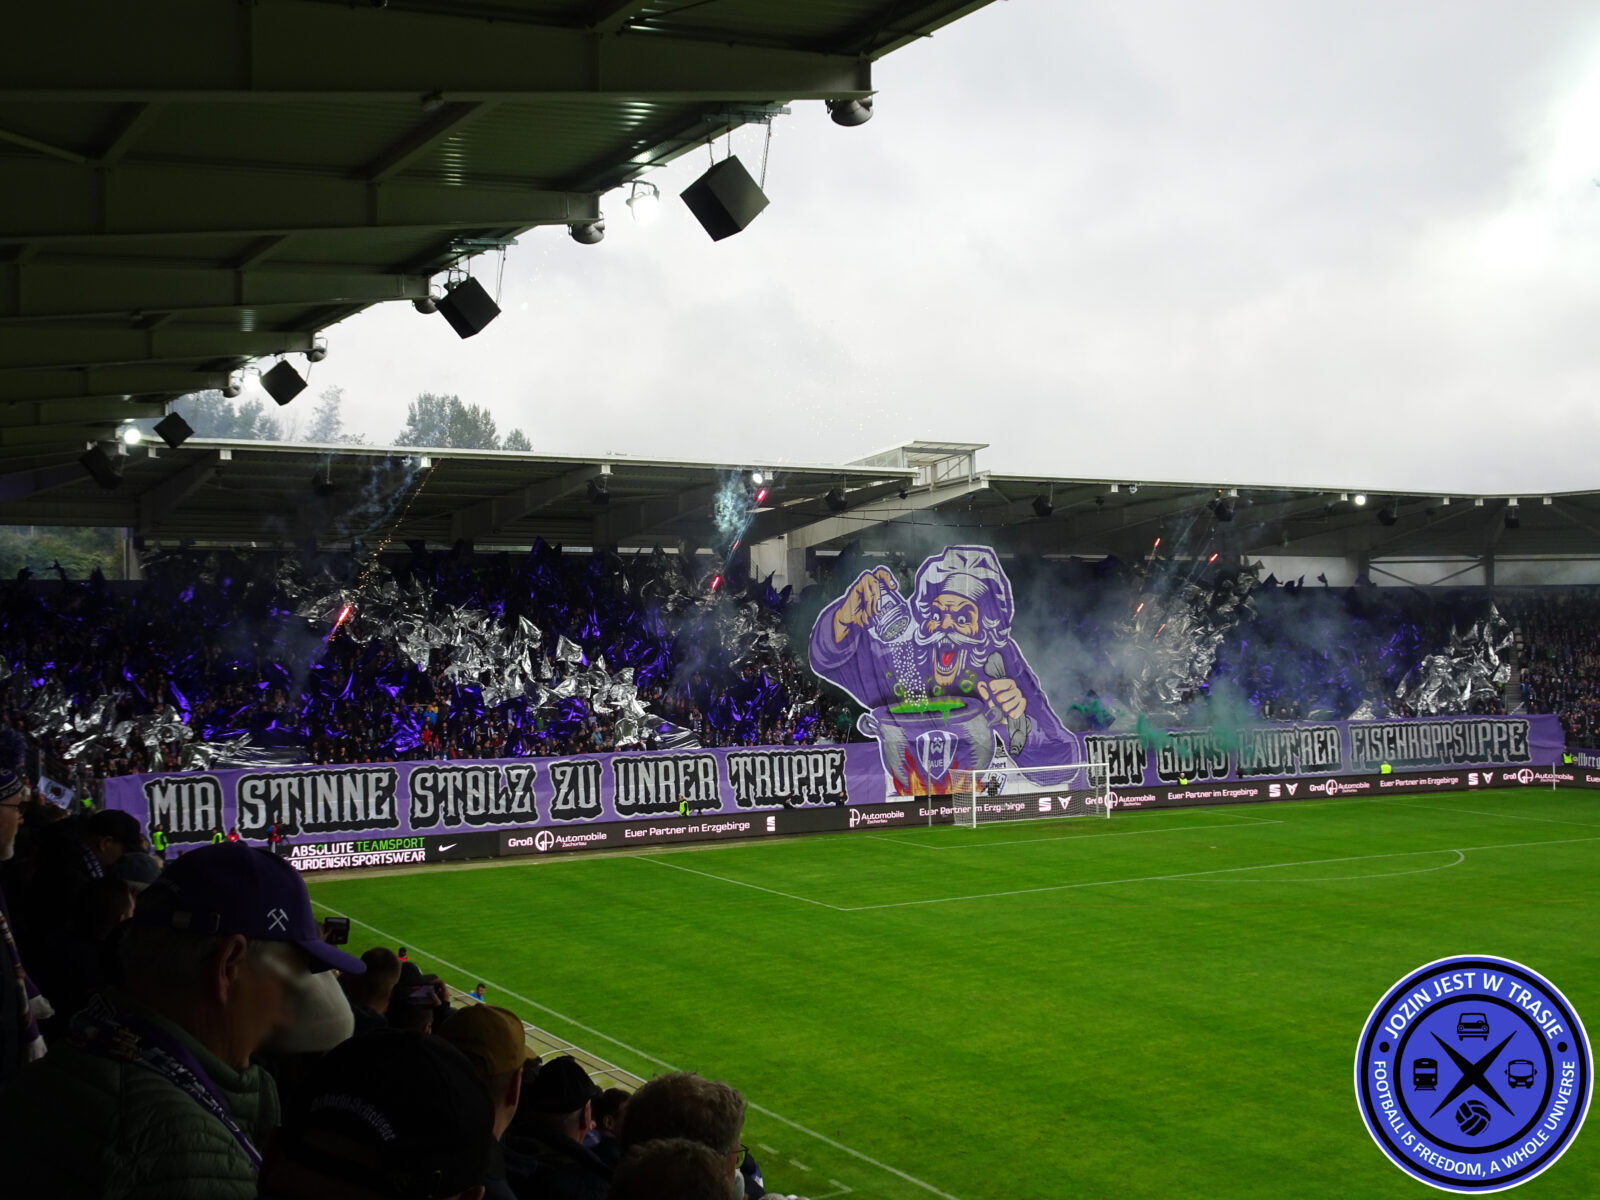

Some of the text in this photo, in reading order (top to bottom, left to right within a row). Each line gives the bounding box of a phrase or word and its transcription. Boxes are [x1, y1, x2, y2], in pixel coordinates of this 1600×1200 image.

[411, 766, 537, 826] STOLZ
[550, 762, 602, 818] ZU
[728, 751, 845, 805] TRUPPE
[1338, 782, 1370, 790] Automobile
[1380, 780, 1394, 788] Euer
[1395, 778, 1418, 787] Partner
[1118, 794, 1156, 803] Automobile
[1168, 792, 1184, 800] Euer
[1185, 790, 1211, 799] Partner
[1222, 788, 1258, 797] Erzgebirge
[861, 810, 905, 821] Automobile
[624, 821, 750, 838] Euer Partner im Erzgebirge
[508, 837, 533, 847] Groß
[555, 832, 607, 843] Automobile
[291, 837, 425, 858] ABSOLUTE TEAMSPORT
[352, 851, 426, 867] SPORTSWEAR
